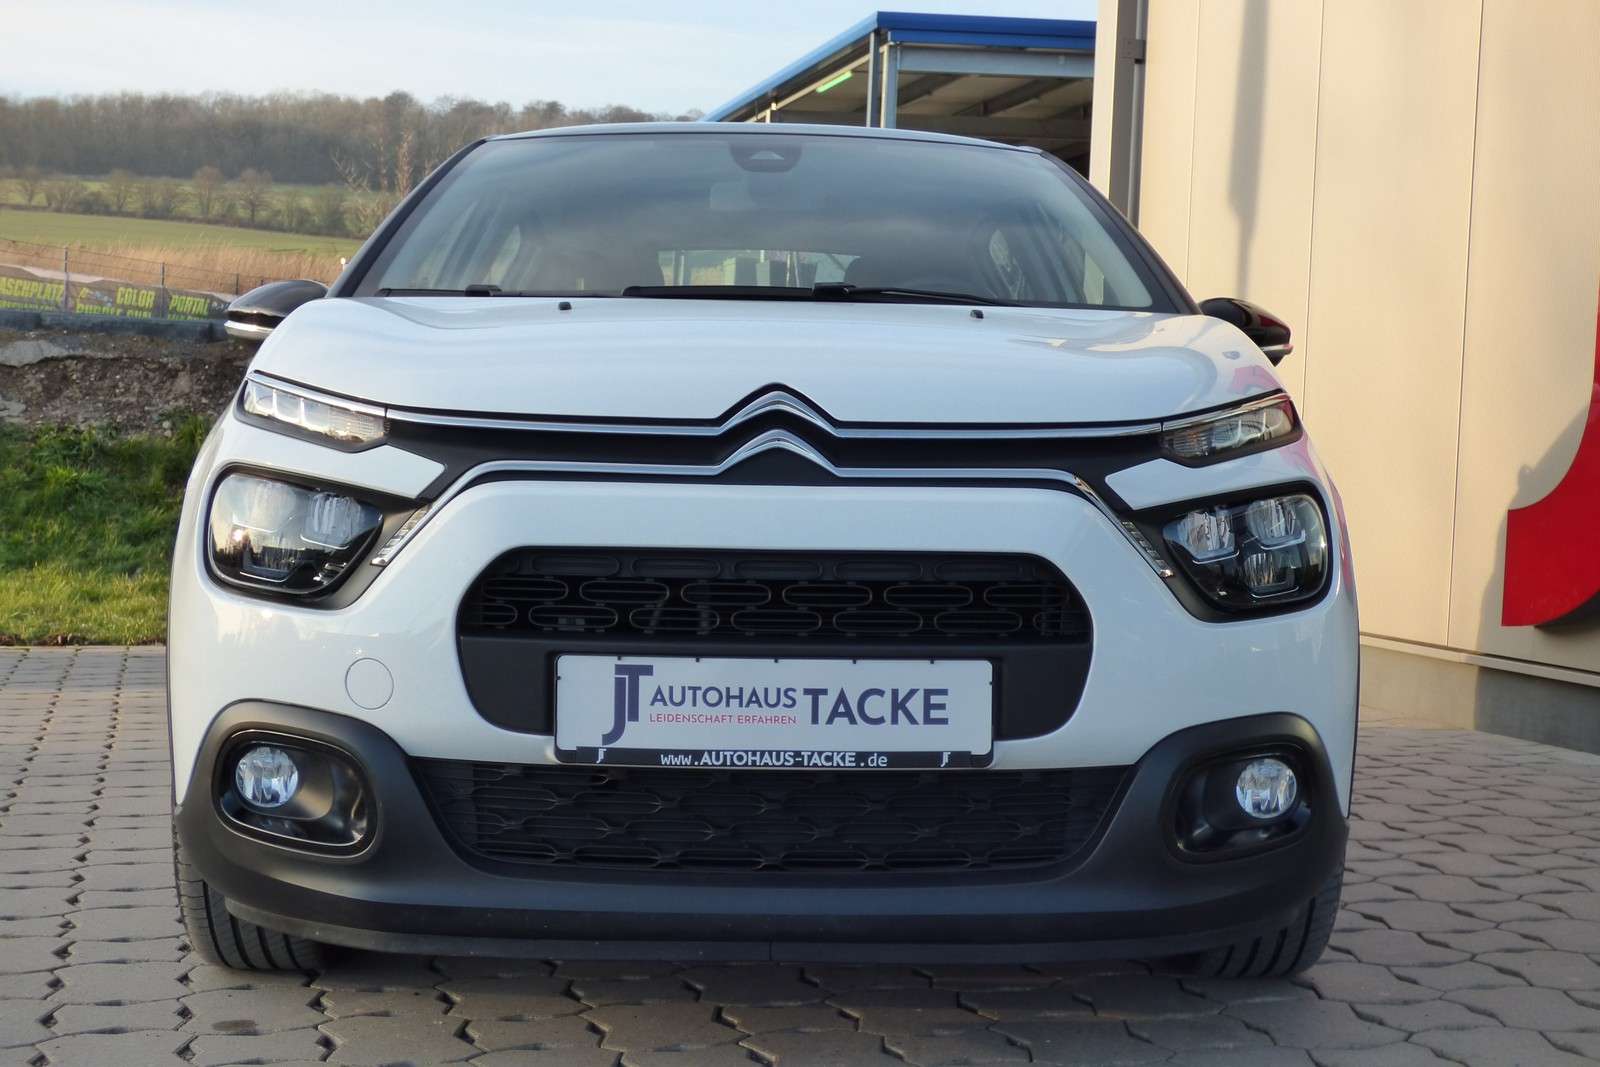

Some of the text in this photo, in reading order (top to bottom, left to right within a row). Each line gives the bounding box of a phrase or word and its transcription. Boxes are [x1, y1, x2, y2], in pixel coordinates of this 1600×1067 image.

[116, 286, 155, 309] COLOR
[169, 295, 209, 317] PORTAL
[650, 685, 949, 725] AUTOHAUS TACKE
[650, 713, 797, 725] LEIDENSCHAFT ERFAHREN
